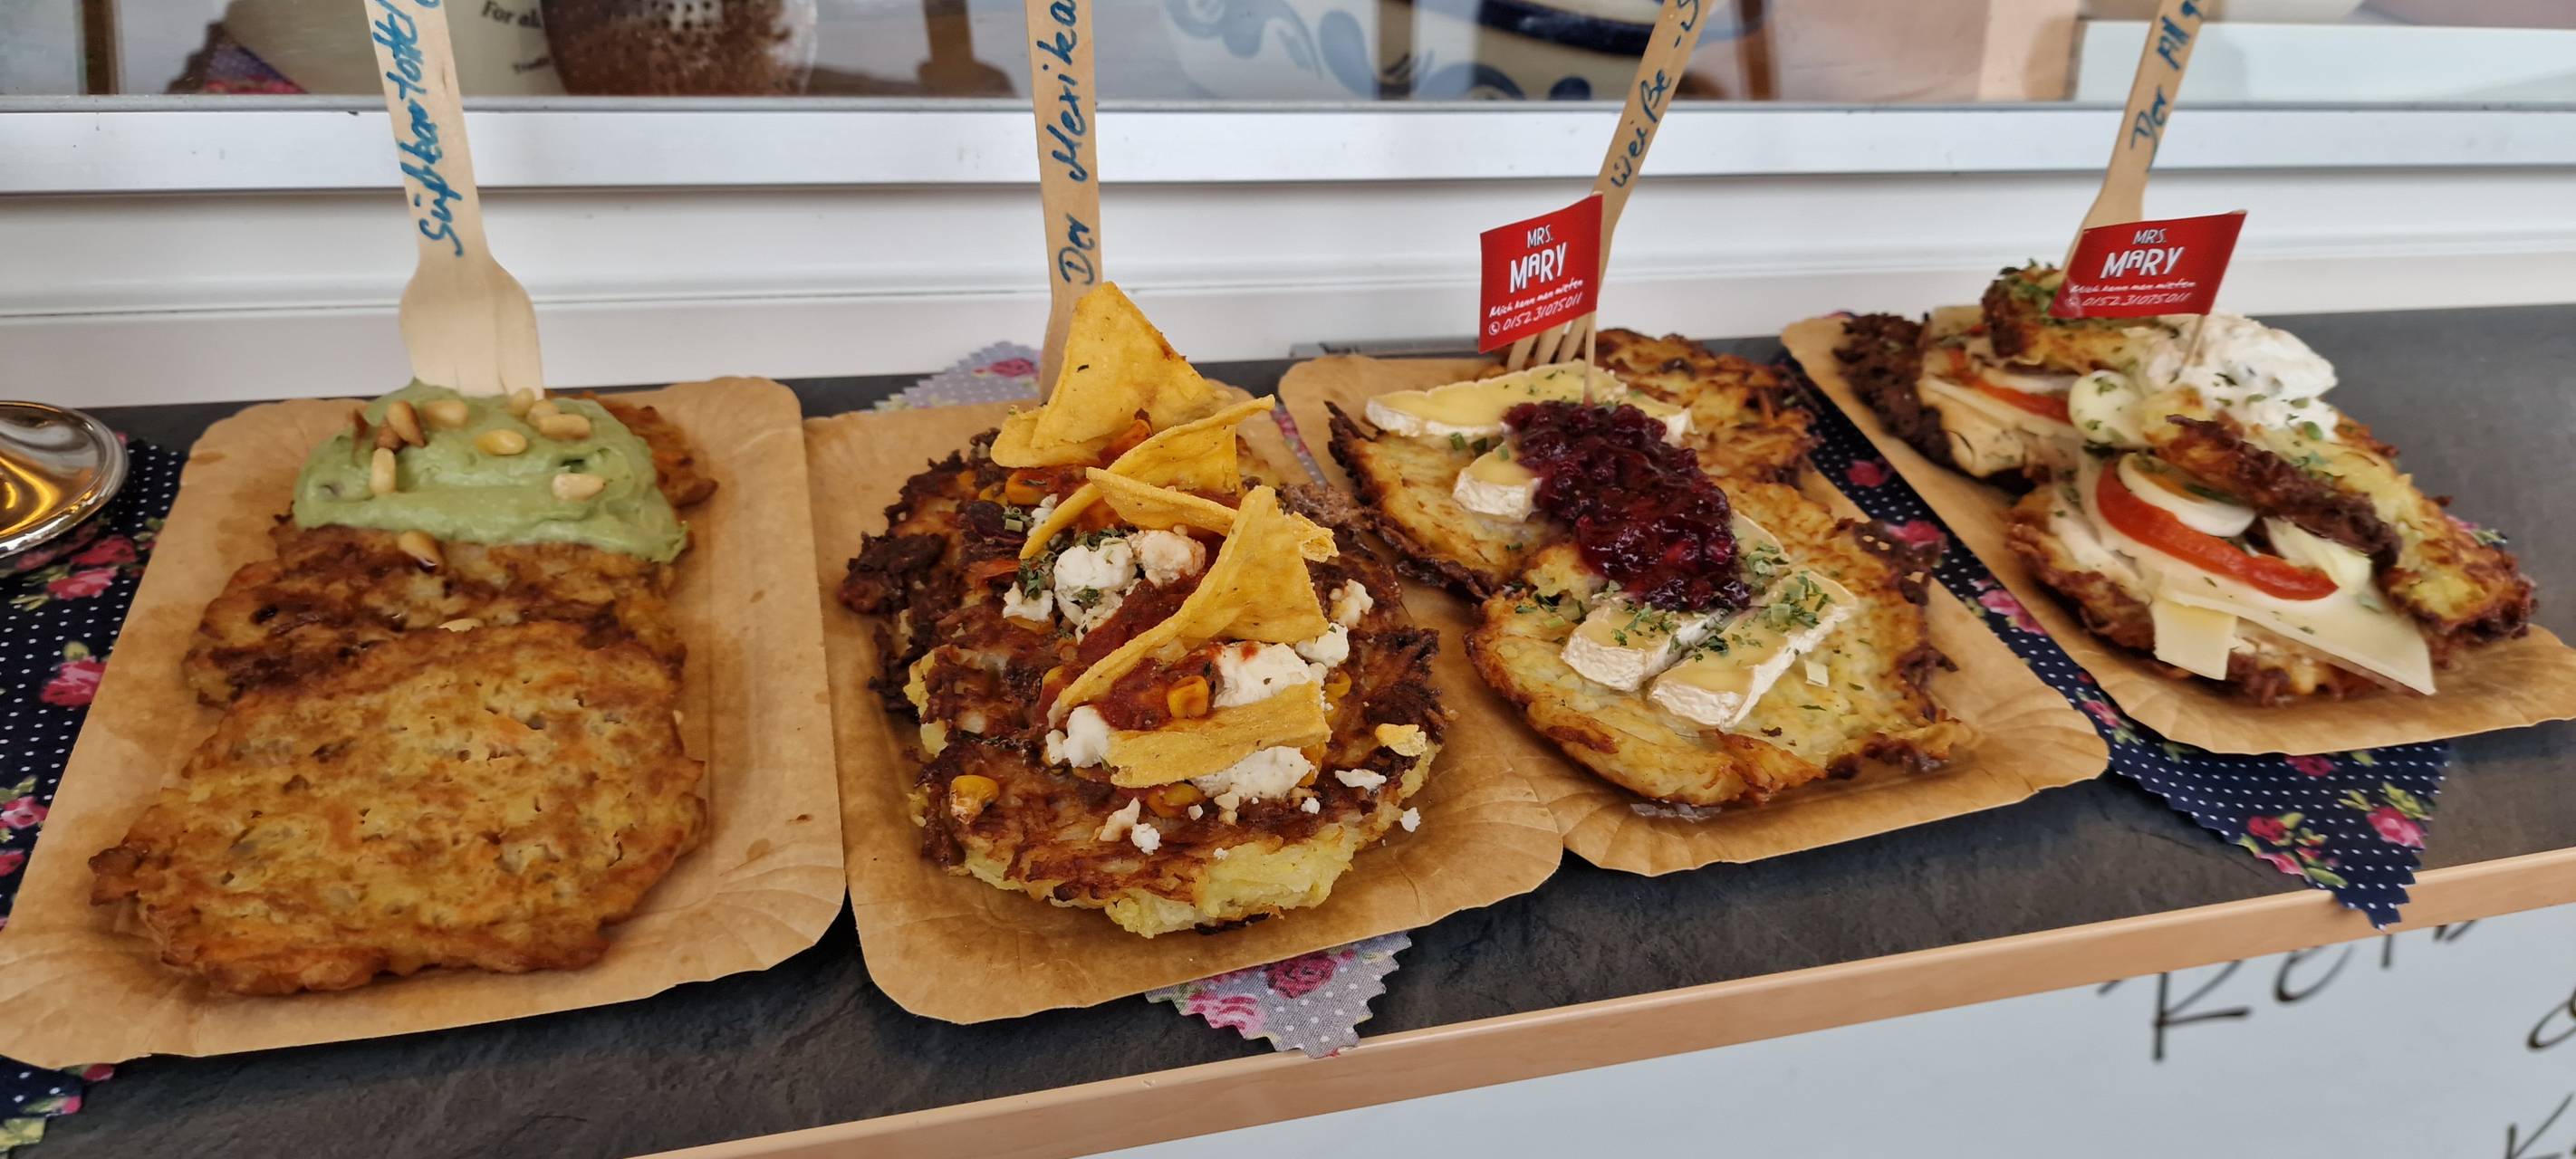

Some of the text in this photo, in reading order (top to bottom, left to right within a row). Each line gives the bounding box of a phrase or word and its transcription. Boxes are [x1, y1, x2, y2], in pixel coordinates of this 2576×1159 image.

[2129, 84, 2167, 173] Der
[1057, 213, 1095, 285] Der
[1510, 241, 1567, 294] MARY
[2100, 245, 2185, 280] MARY
